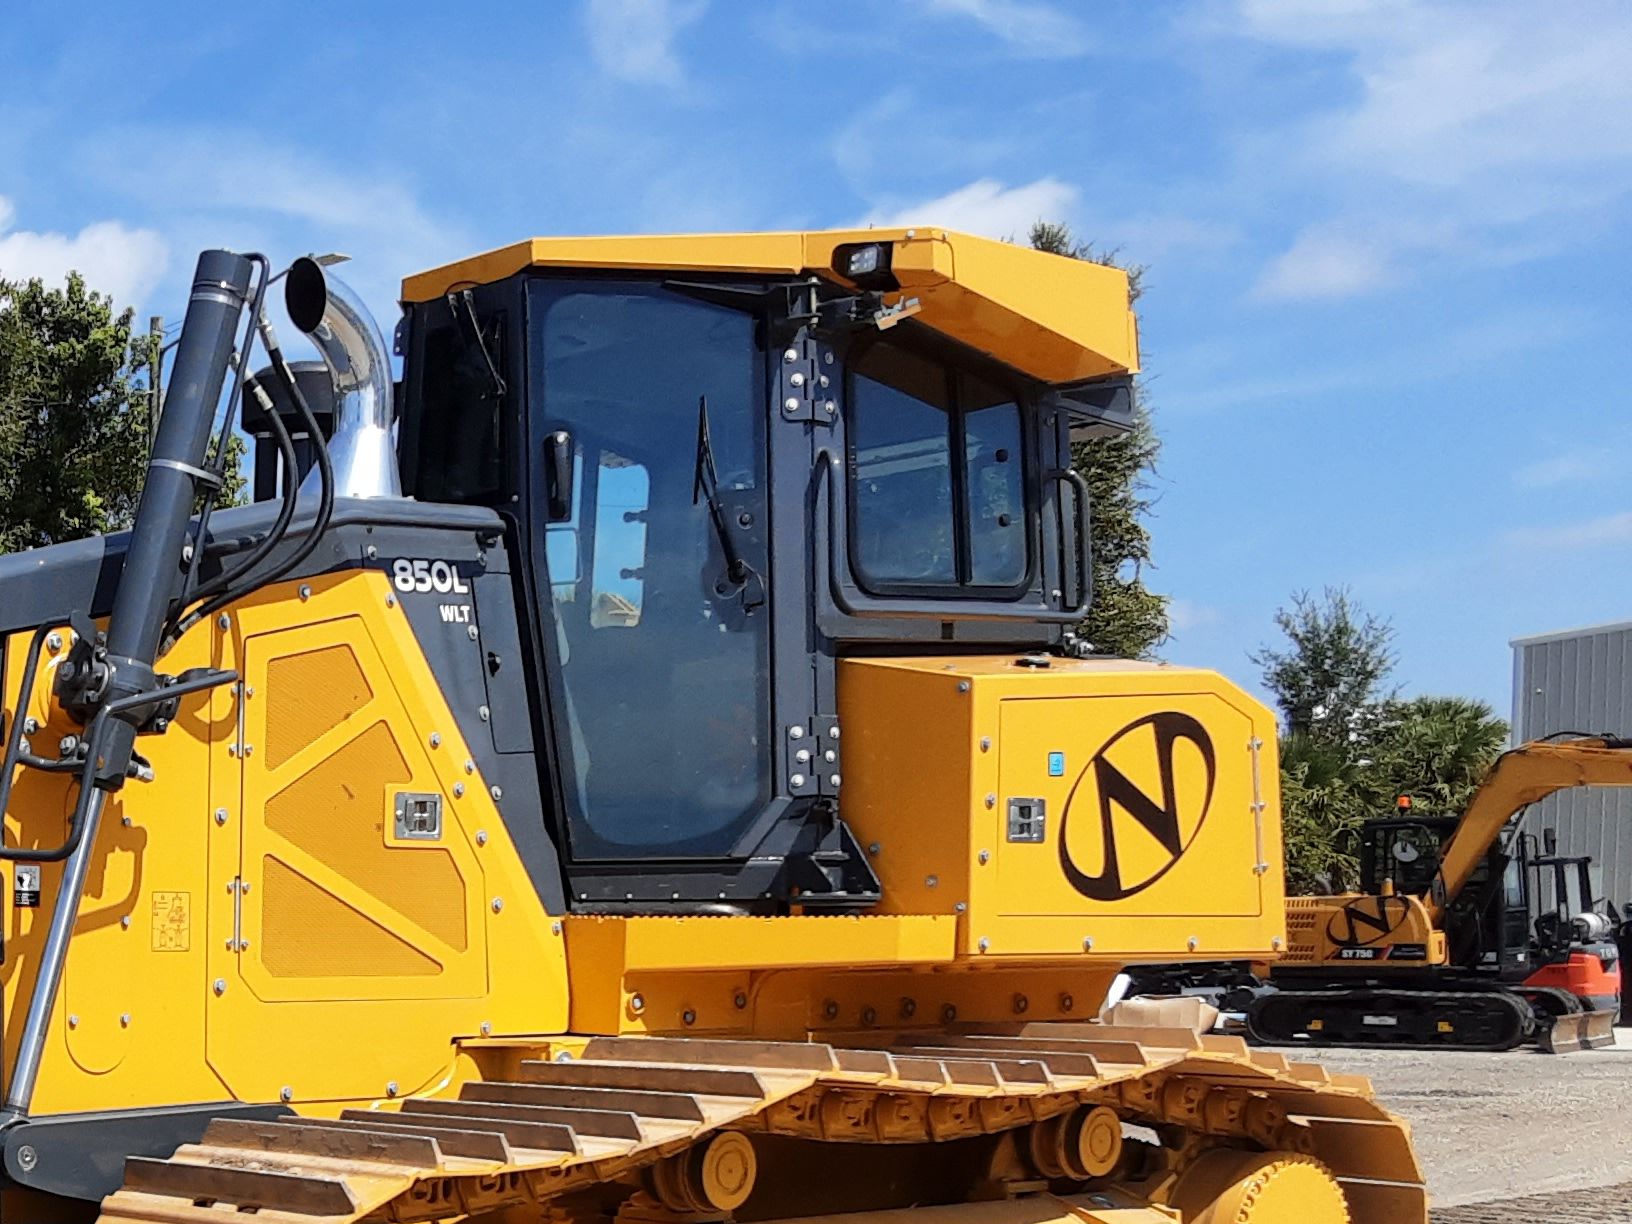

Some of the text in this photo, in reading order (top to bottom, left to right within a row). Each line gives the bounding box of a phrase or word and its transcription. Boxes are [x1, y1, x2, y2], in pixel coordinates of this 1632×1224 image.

[393, 559, 469, 593] 850L
[439, 604, 470, 623] WLT
[1057, 711, 1217, 902] N
